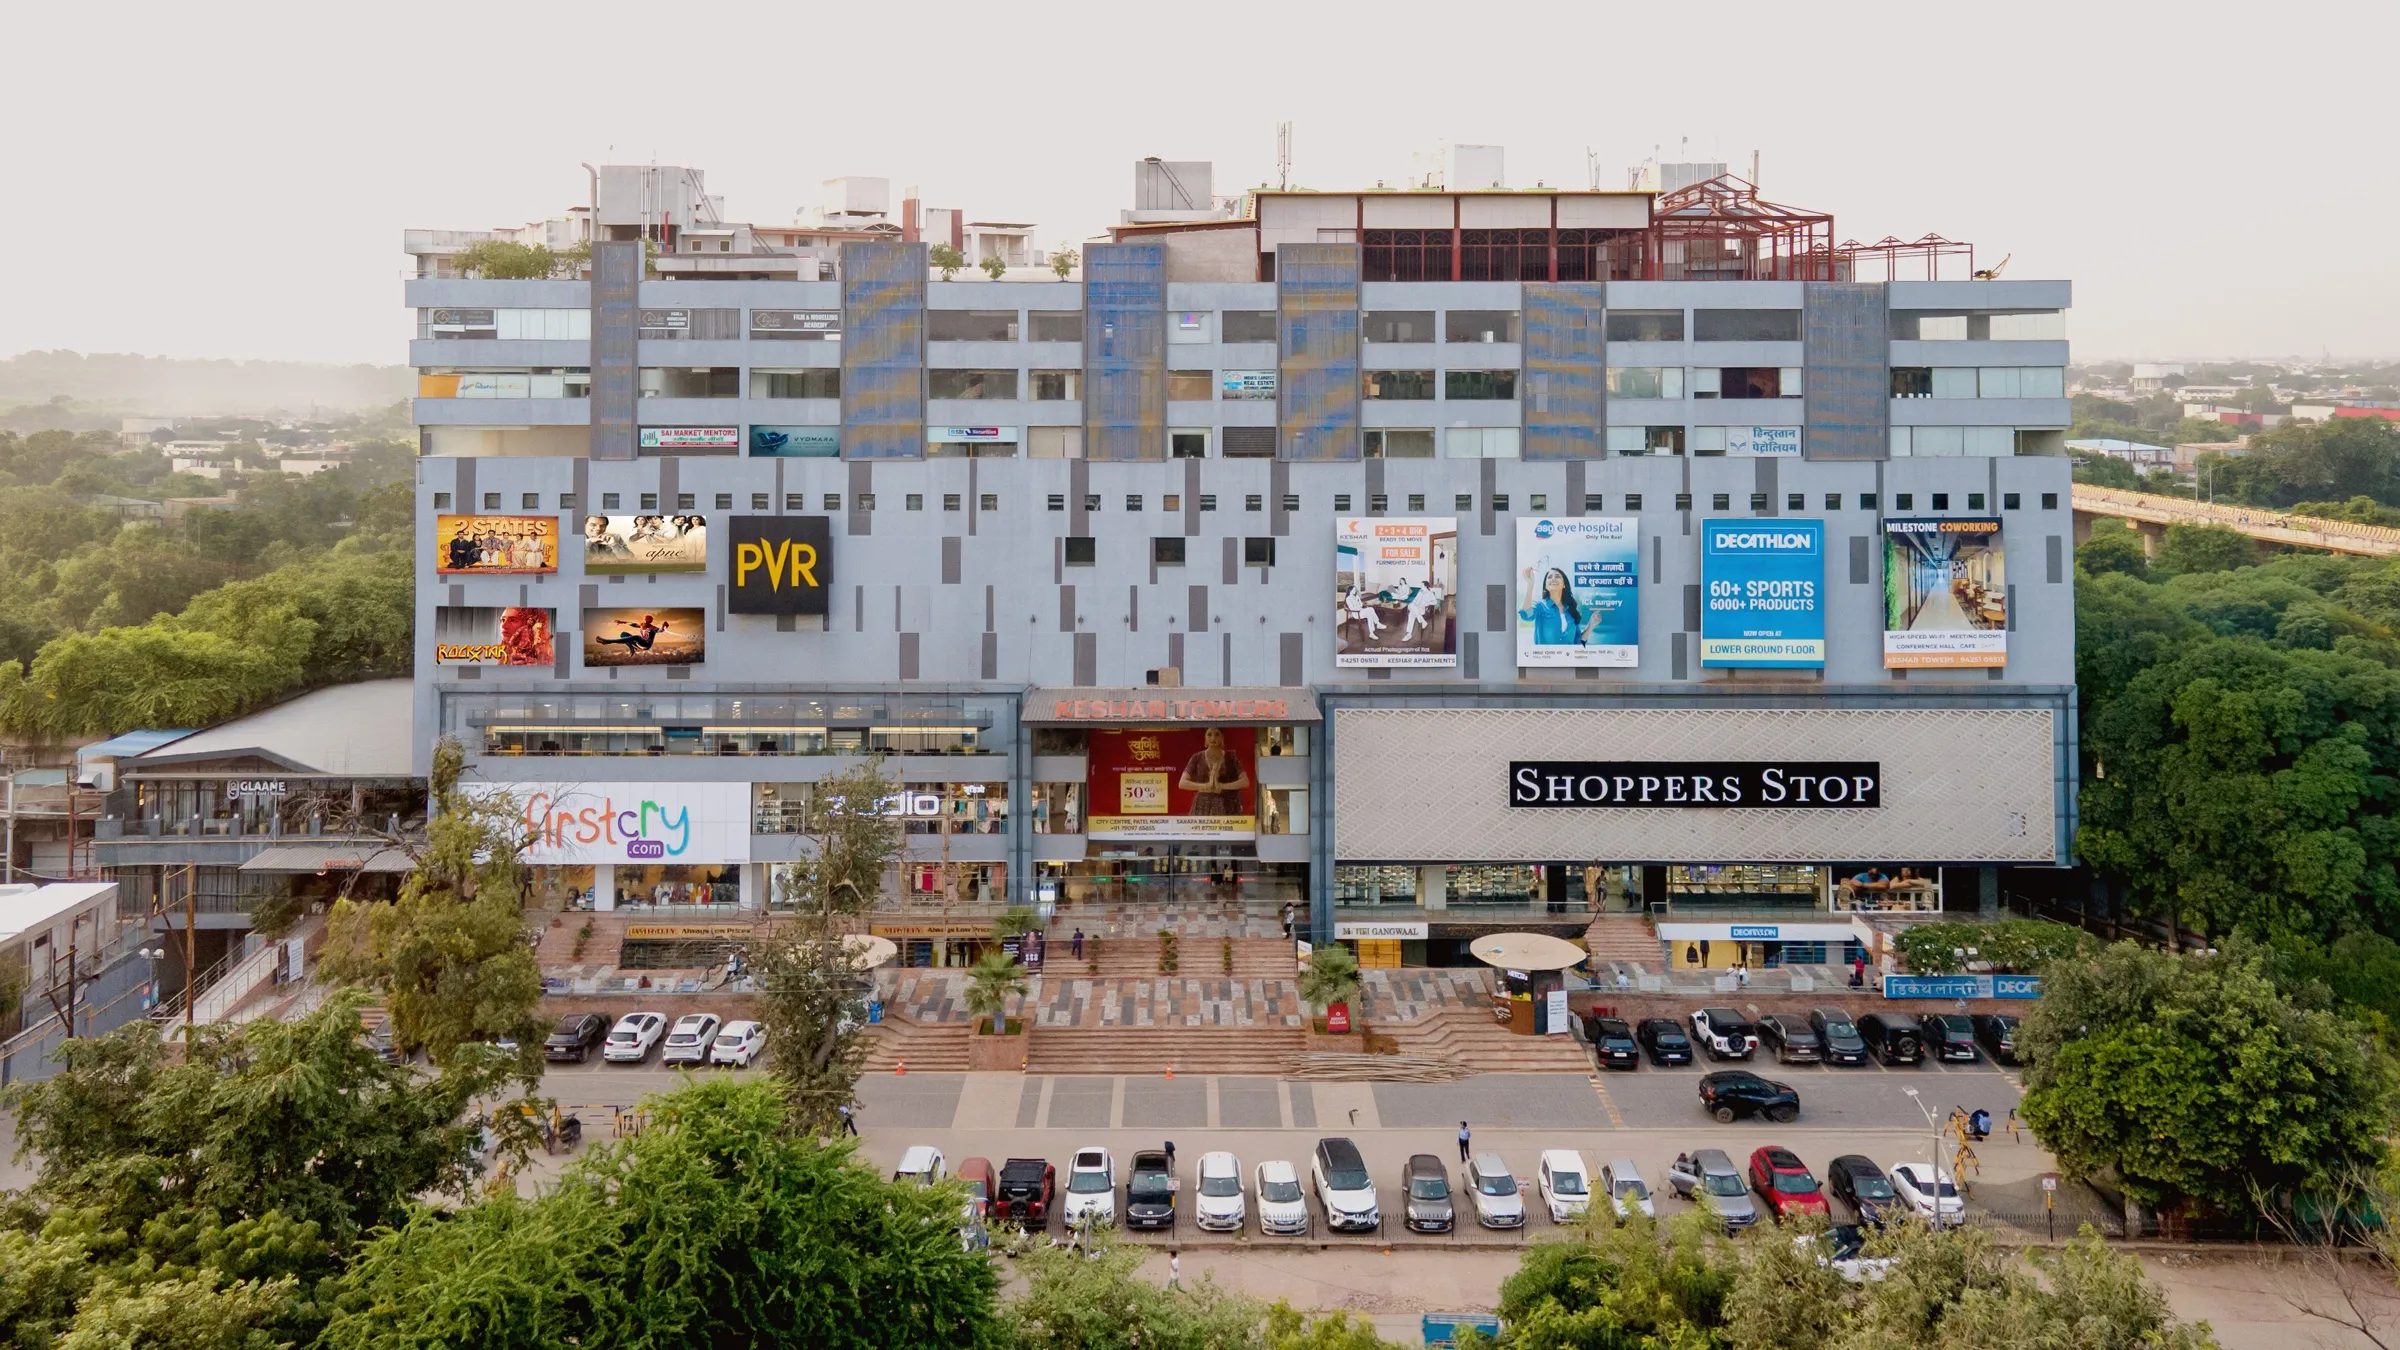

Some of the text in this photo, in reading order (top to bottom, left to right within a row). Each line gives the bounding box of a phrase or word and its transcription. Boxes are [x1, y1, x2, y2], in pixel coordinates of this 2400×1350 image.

[661, 429, 737, 437] SAI MARKET MENTORS
[1752, 426, 1797, 441] हिन्दुस्तान
[454, 519, 471, 536] 2
[472, 519, 549, 537] STATES
[1536, 522, 1623, 535] asg eye hospital
[1886, 522, 1999, 533] MILESTONE COWORKING
[1715, 533, 1811, 549] DECATHLON
[645, 547, 685, 562] apne
[1385, 548, 1417, 558] FOR SALE
[737, 536, 820, 594] PVR
[1710, 580, 1815, 597] 60+ SPORTS
[1595, 599, 1623, 607] surgery
[1710, 599, 1815, 611] 6000+ PRODUCTS
[436, 643, 509, 664] ROCKSTAR
[1710, 645, 1815, 655] LOWER GROUND FLOOR
[1055, 700, 1289, 719] KESHAR TOWERS
[1515, 766, 1875, 803] SHOPPERS STOP
[1124, 786, 1156, 799] 50%
[525, 793, 690, 856] firstcry
[628, 844, 662, 855] .com
[927, 926, 955, 934] Alwys
